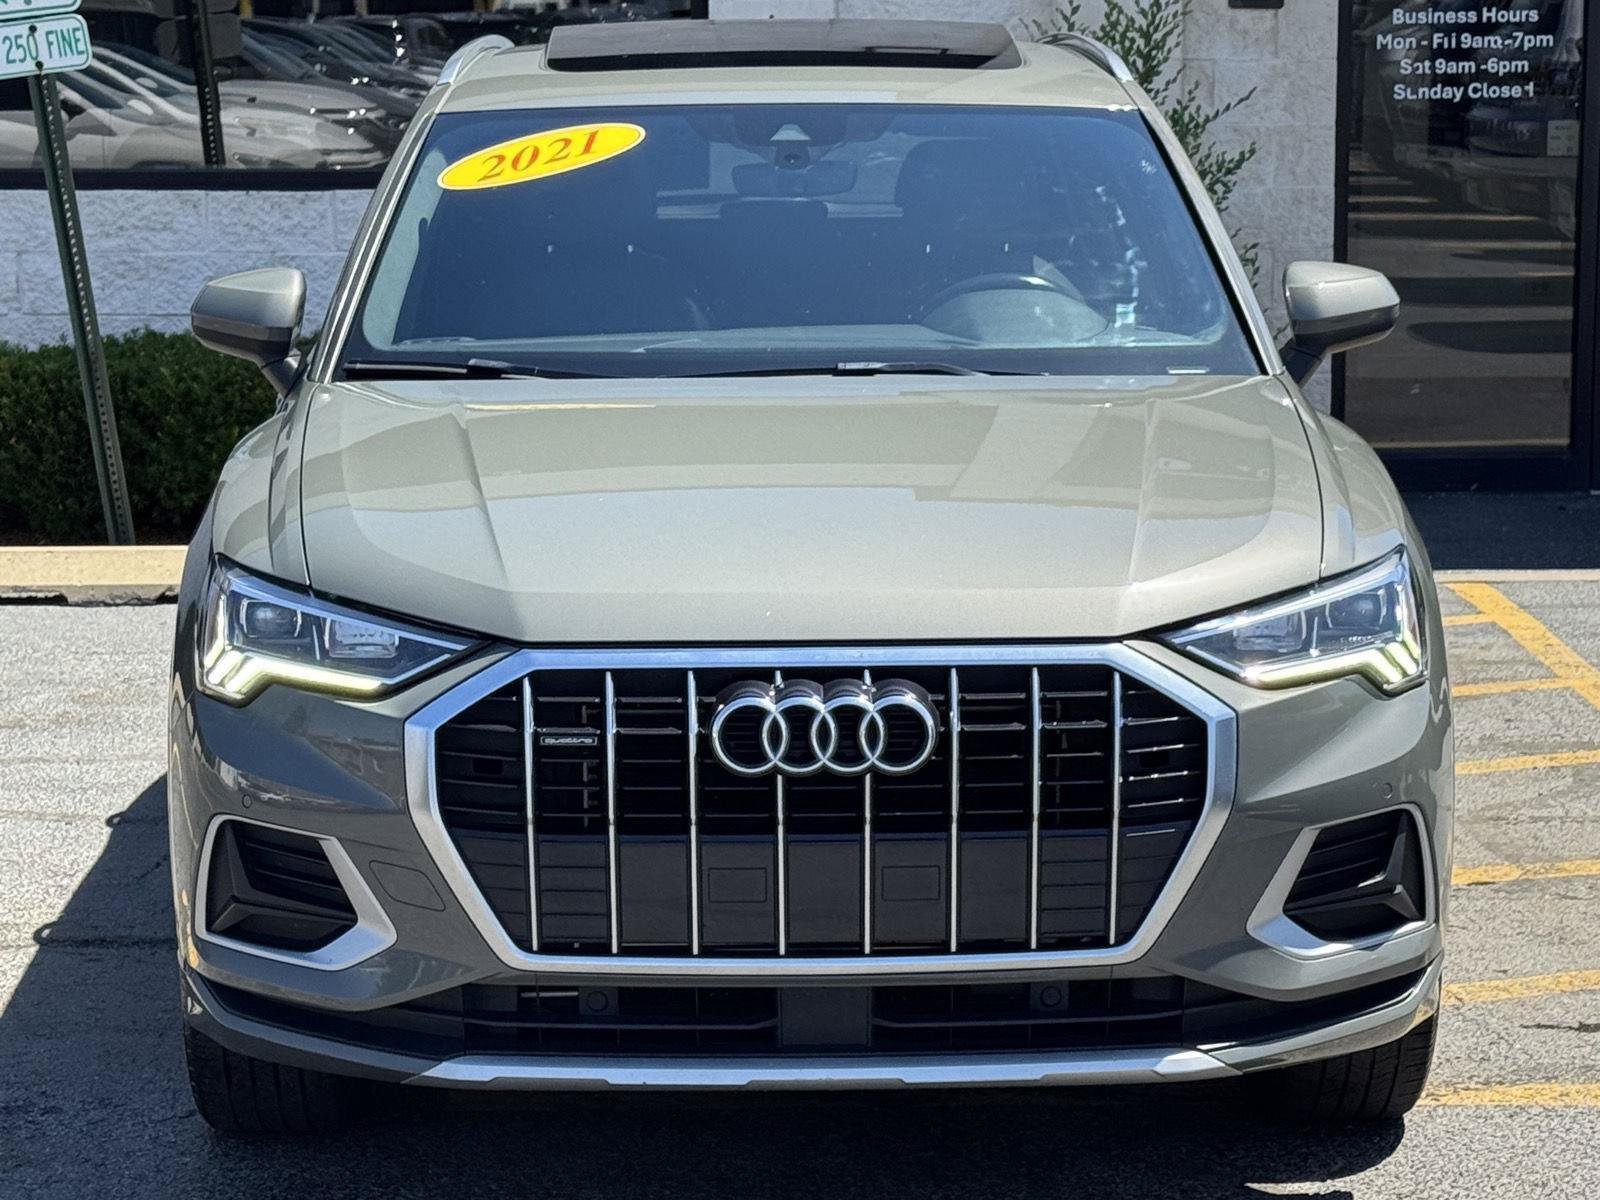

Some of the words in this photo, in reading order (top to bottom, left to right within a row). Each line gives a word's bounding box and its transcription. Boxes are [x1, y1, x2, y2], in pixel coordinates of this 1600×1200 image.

[1392, 8, 1477, 25] Business
[1482, 6, 1539, 23] Hours
[45, 27, 85, 59] FINE
[1376, 33, 1416, 50] Mon
[1400, 59, 1432, 75] Sat
[1435, 58, 1476, 74] 9am
[476, 129, 599, 183] 2021
